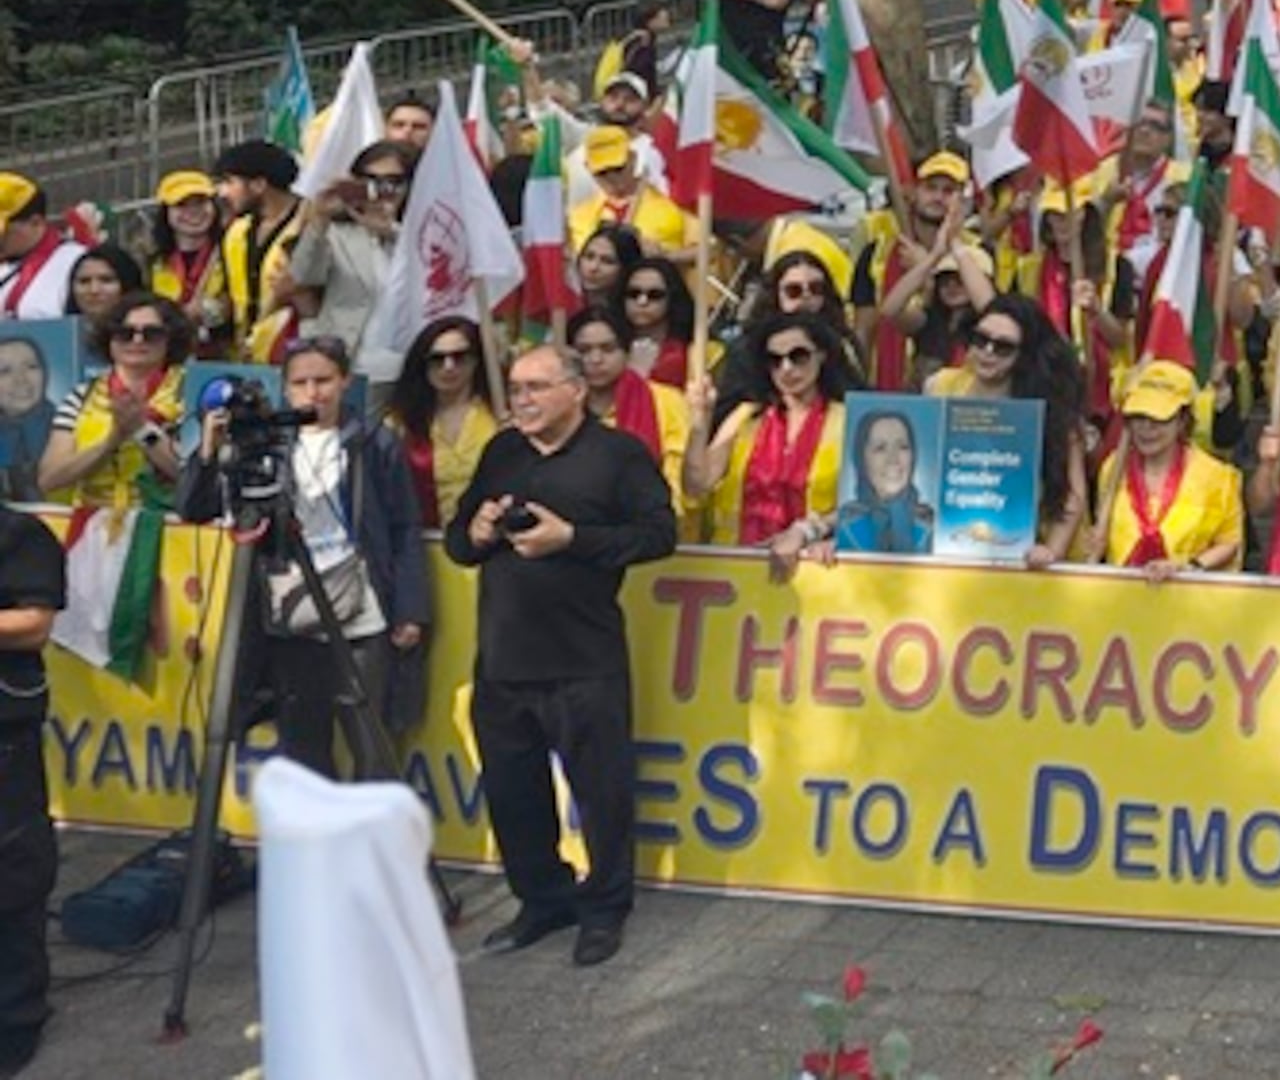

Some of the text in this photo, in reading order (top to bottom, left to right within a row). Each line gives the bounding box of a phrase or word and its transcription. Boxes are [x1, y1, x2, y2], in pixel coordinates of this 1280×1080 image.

[948, 448, 1021, 472] Complete
[946, 468, 1002, 487] Gender
[945, 487, 1009, 513] Equality
[803, 779, 909, 856] TO
[932, 788, 987, 868] A
